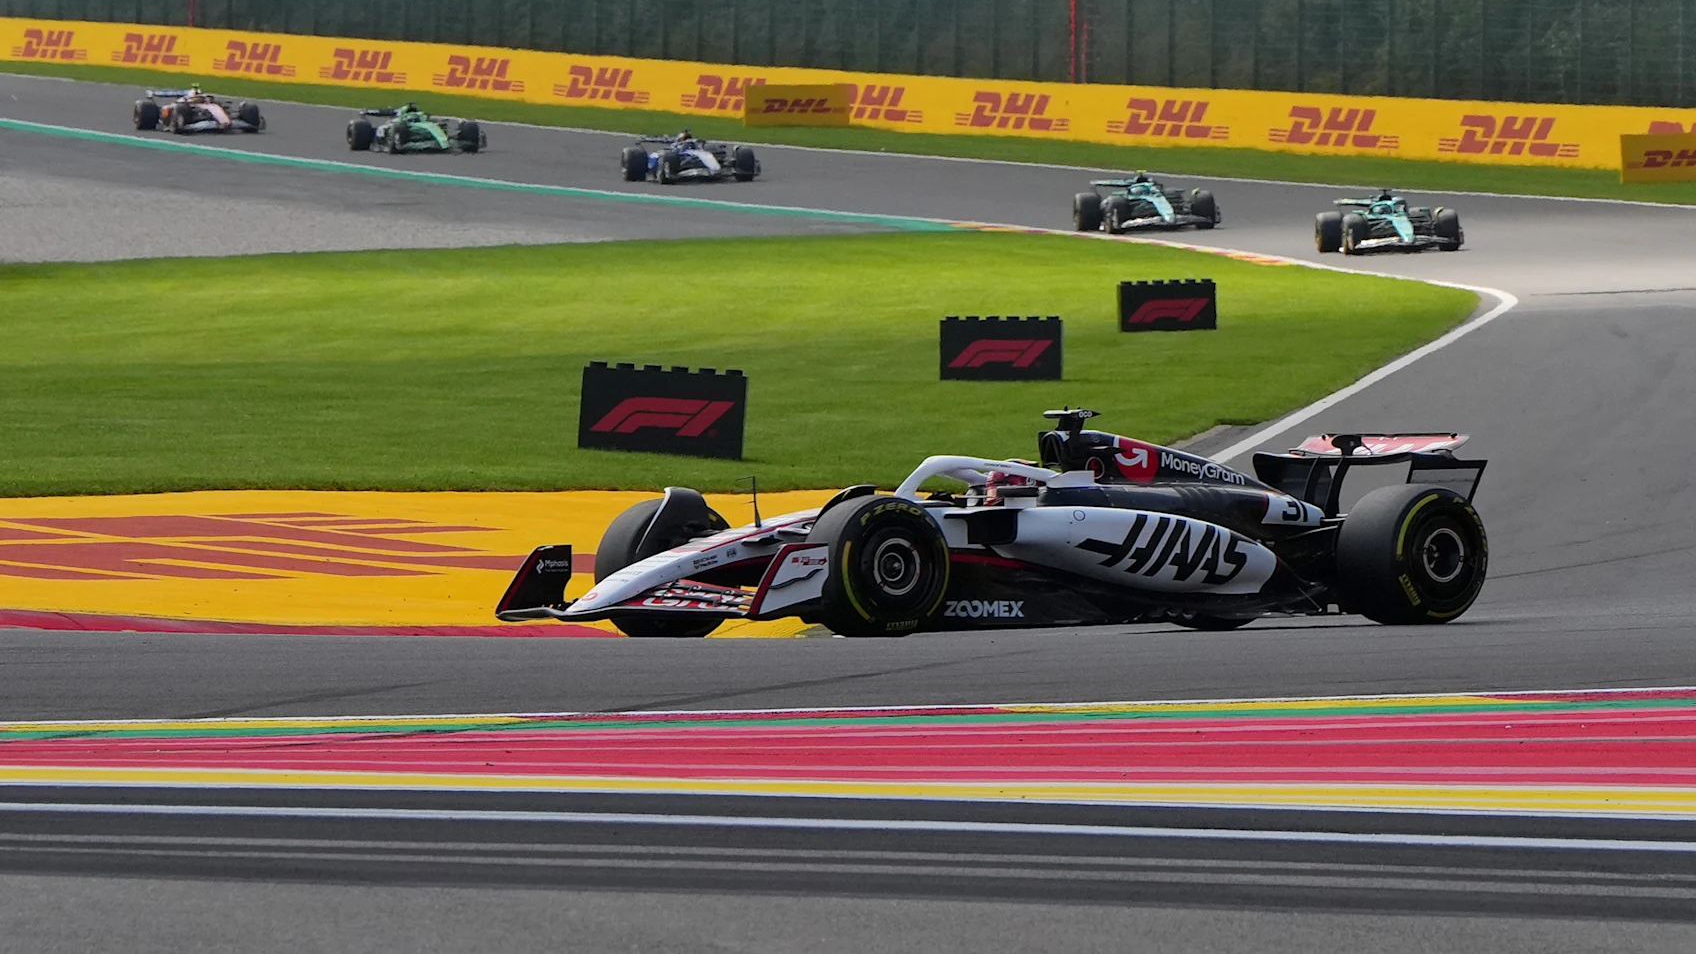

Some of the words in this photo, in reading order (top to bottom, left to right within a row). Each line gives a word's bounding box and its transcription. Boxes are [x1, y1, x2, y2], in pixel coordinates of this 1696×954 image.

[23, 29, 74, 60] DHL
[122, 33, 178, 66] DHL
[225, 41, 283, 76] DHL
[331, 48, 393, 83] DHL
[445, 55, 512, 92] DHL
[565, 65, 636, 103] DHL
[694, 74, 767, 111] DH
[763, 98, 831, 114] DHL
[969, 92, 1053, 131] DHL
[1124, 98, 1212, 139] DHL
[1287, 106, 1381, 148] DHL
[1457, 114, 1560, 157] DHL
[1128, 298, 1209, 322] F1
[948, 339, 1053, 368] F1
[590, 397, 735, 437] F1
[1161, 452, 1245, 485] MoneyGram
[1075, 514, 1247, 584] HAAS
[944, 600, 1024, 617] ZOOMEX
